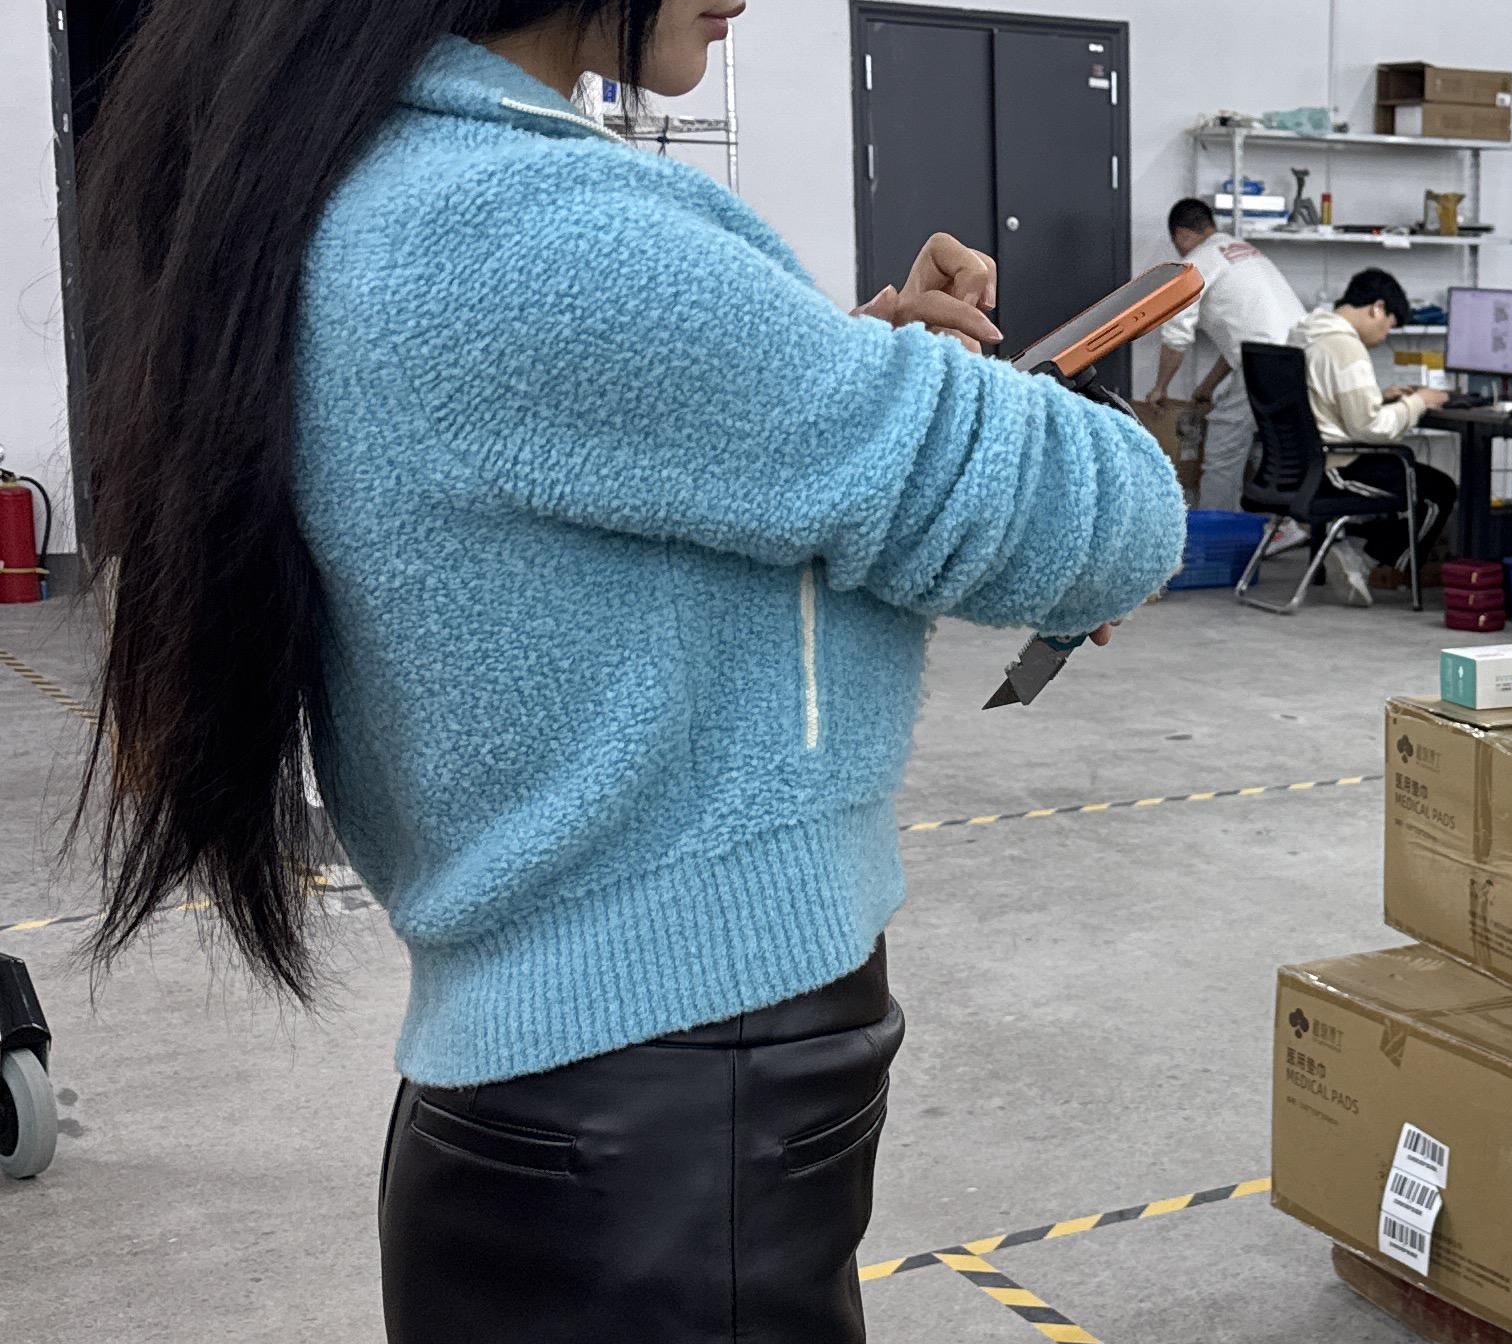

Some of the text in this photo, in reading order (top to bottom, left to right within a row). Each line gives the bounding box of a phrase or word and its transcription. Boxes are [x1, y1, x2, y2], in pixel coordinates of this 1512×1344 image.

[1394, 792, 1456, 830] MEDICAL PADS
[1285, 1068, 1330, 1101] MEDICAL
[1331, 1088, 1360, 1114] PADS
